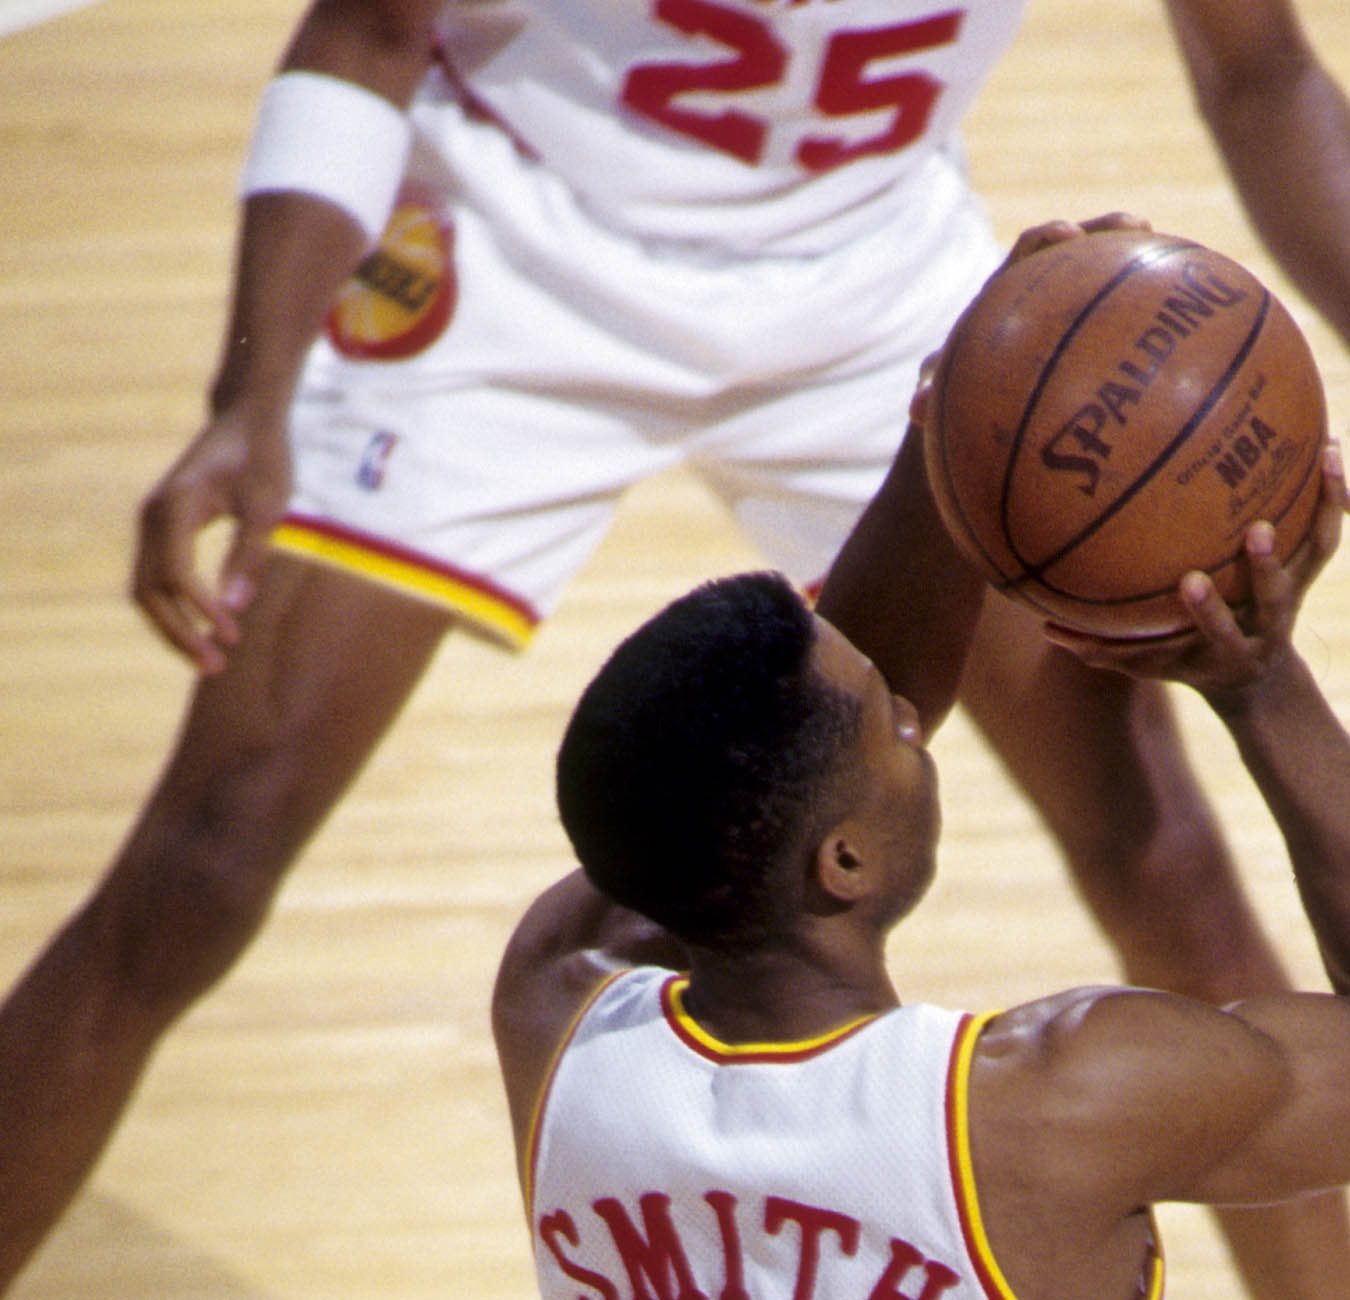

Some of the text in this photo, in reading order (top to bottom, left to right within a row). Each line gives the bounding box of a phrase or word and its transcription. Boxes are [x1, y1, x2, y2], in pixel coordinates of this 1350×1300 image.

[619, 0, 966, 171] 25
[1041, 262, 1248, 495] SPALDING
[1215, 416, 1277, 488] NBA
